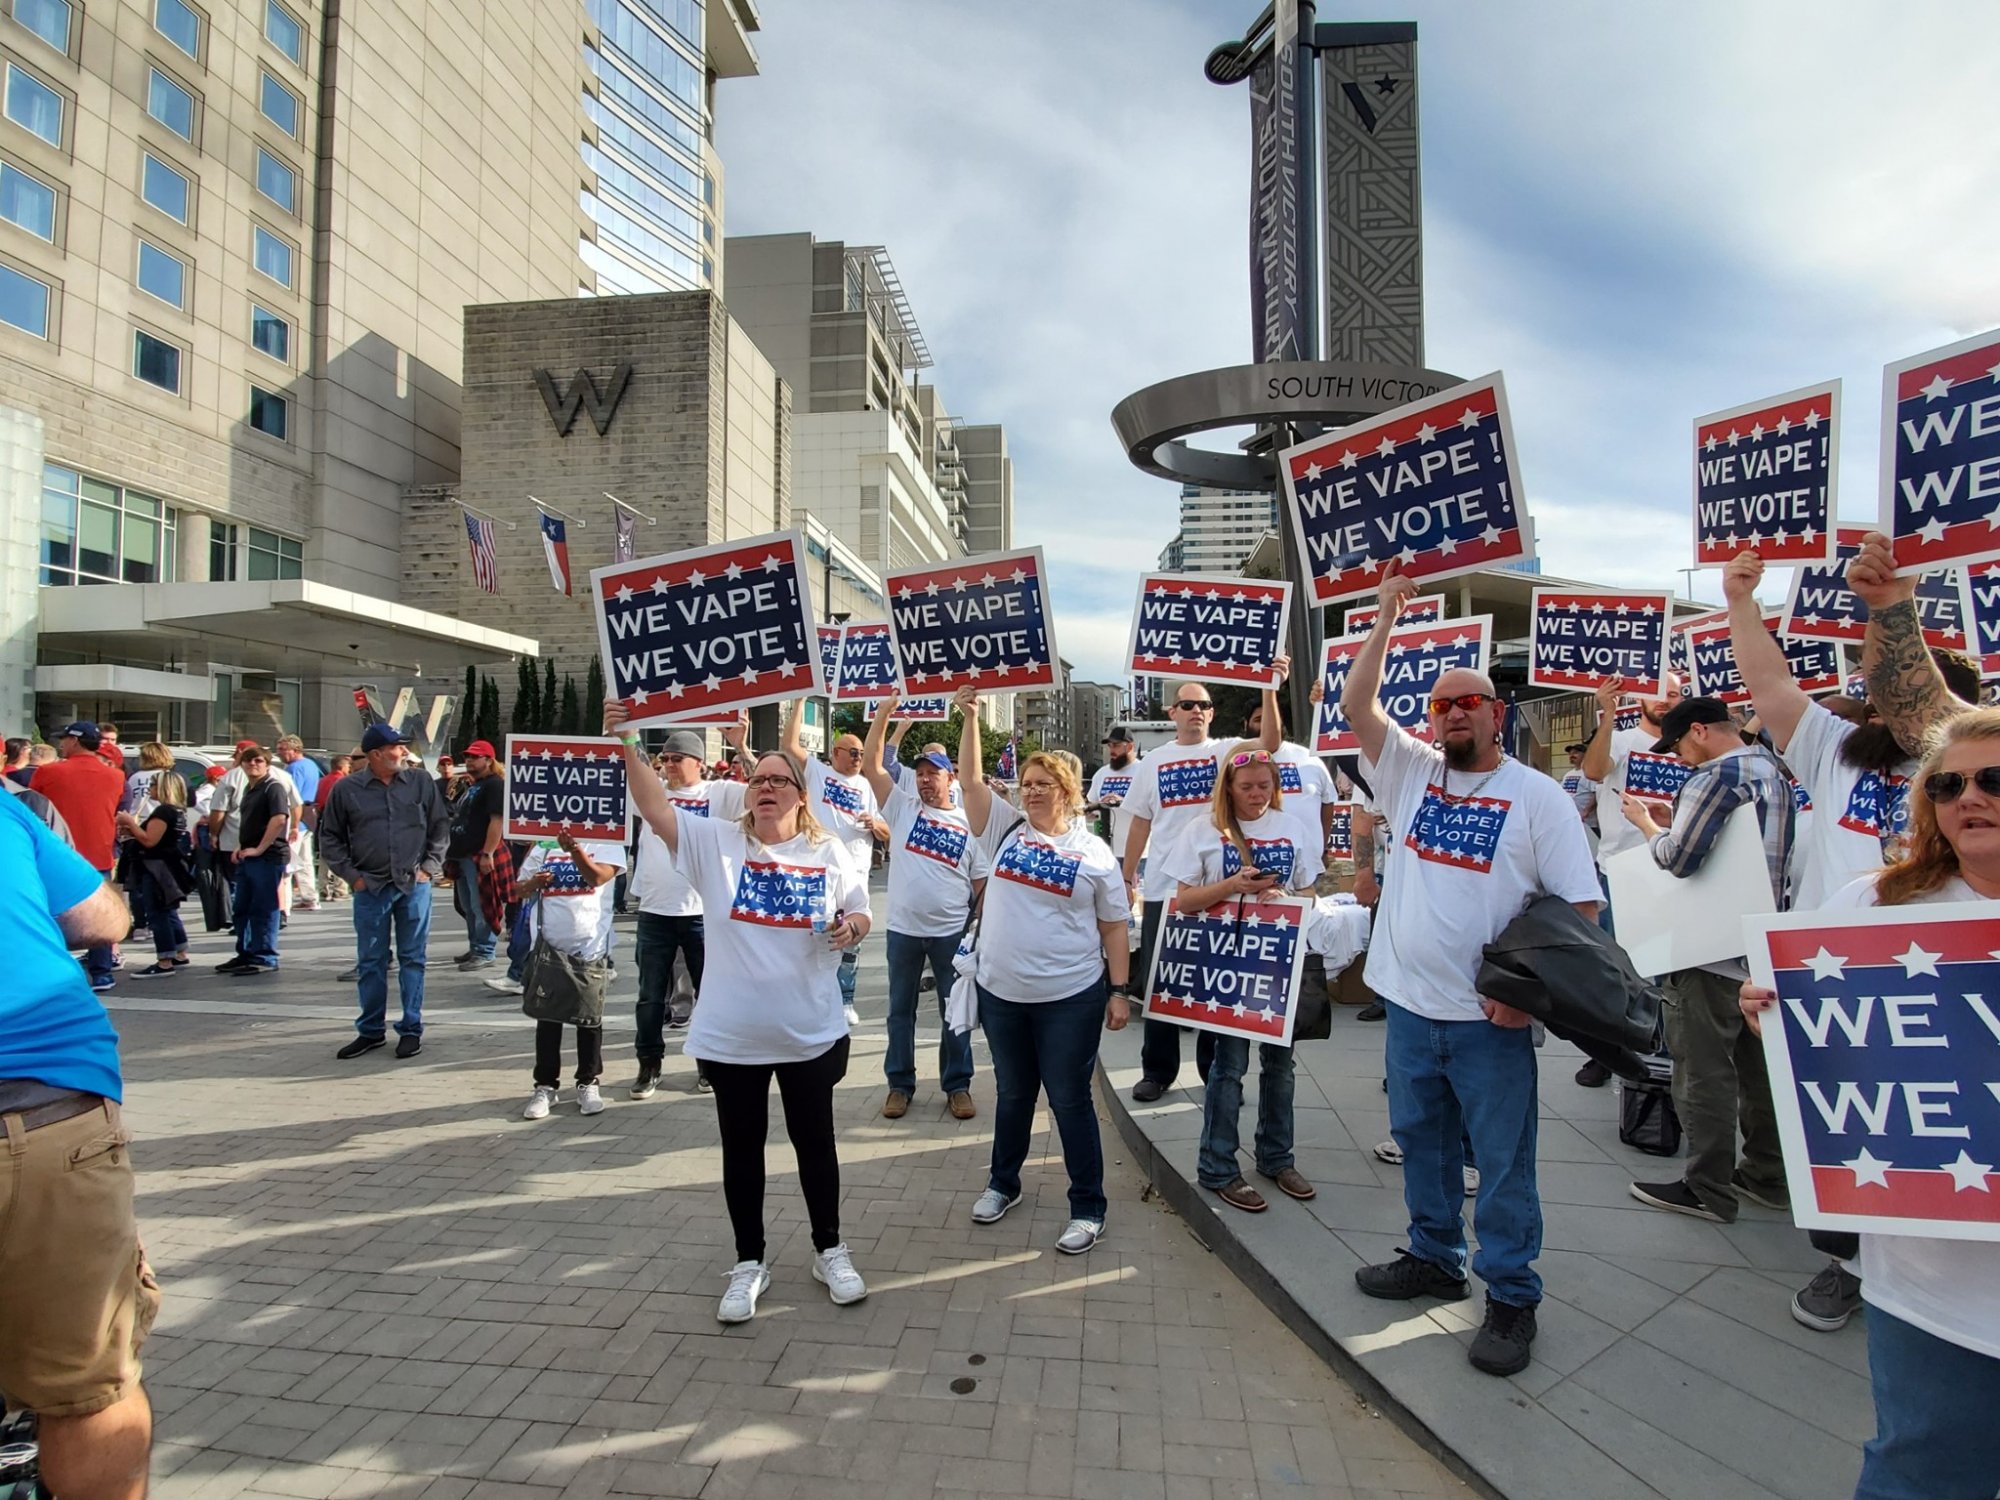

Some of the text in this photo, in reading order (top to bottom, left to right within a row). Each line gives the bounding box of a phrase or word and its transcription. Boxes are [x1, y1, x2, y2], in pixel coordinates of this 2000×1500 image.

[1268, 376, 1354, 399] SOUTH
[532, 364, 632, 437] W
[1700, 455, 1735, 487] WE
[1299, 477, 1361, 519] WE
[1700, 499, 1735, 528] WE
[1308, 521, 1370, 561] WE
[1144, 602, 1187, 621] WE
[1801, 588, 1854, 611] WE
[608, 602, 670, 640] WE
[894, 603, 941, 630] WE
[1538, 617, 1576, 636] WE
[846, 642, 881, 657] WE
[1140, 629, 1183, 649] WE
[615, 646, 678, 683] WE
[901, 639, 947, 665] WE
[1537, 644, 1574, 663] WE
[843, 663, 879, 679] WE
[512, 765, 548, 784] WE
[511, 793, 547, 812] WE
[740, 889, 765, 904] WE
[1166, 927, 1202, 951] WE
[1159, 961, 1196, 987] WE
[1783, 993, 1949, 1049] WE
[1801, 1080, 1971, 1140] WE
